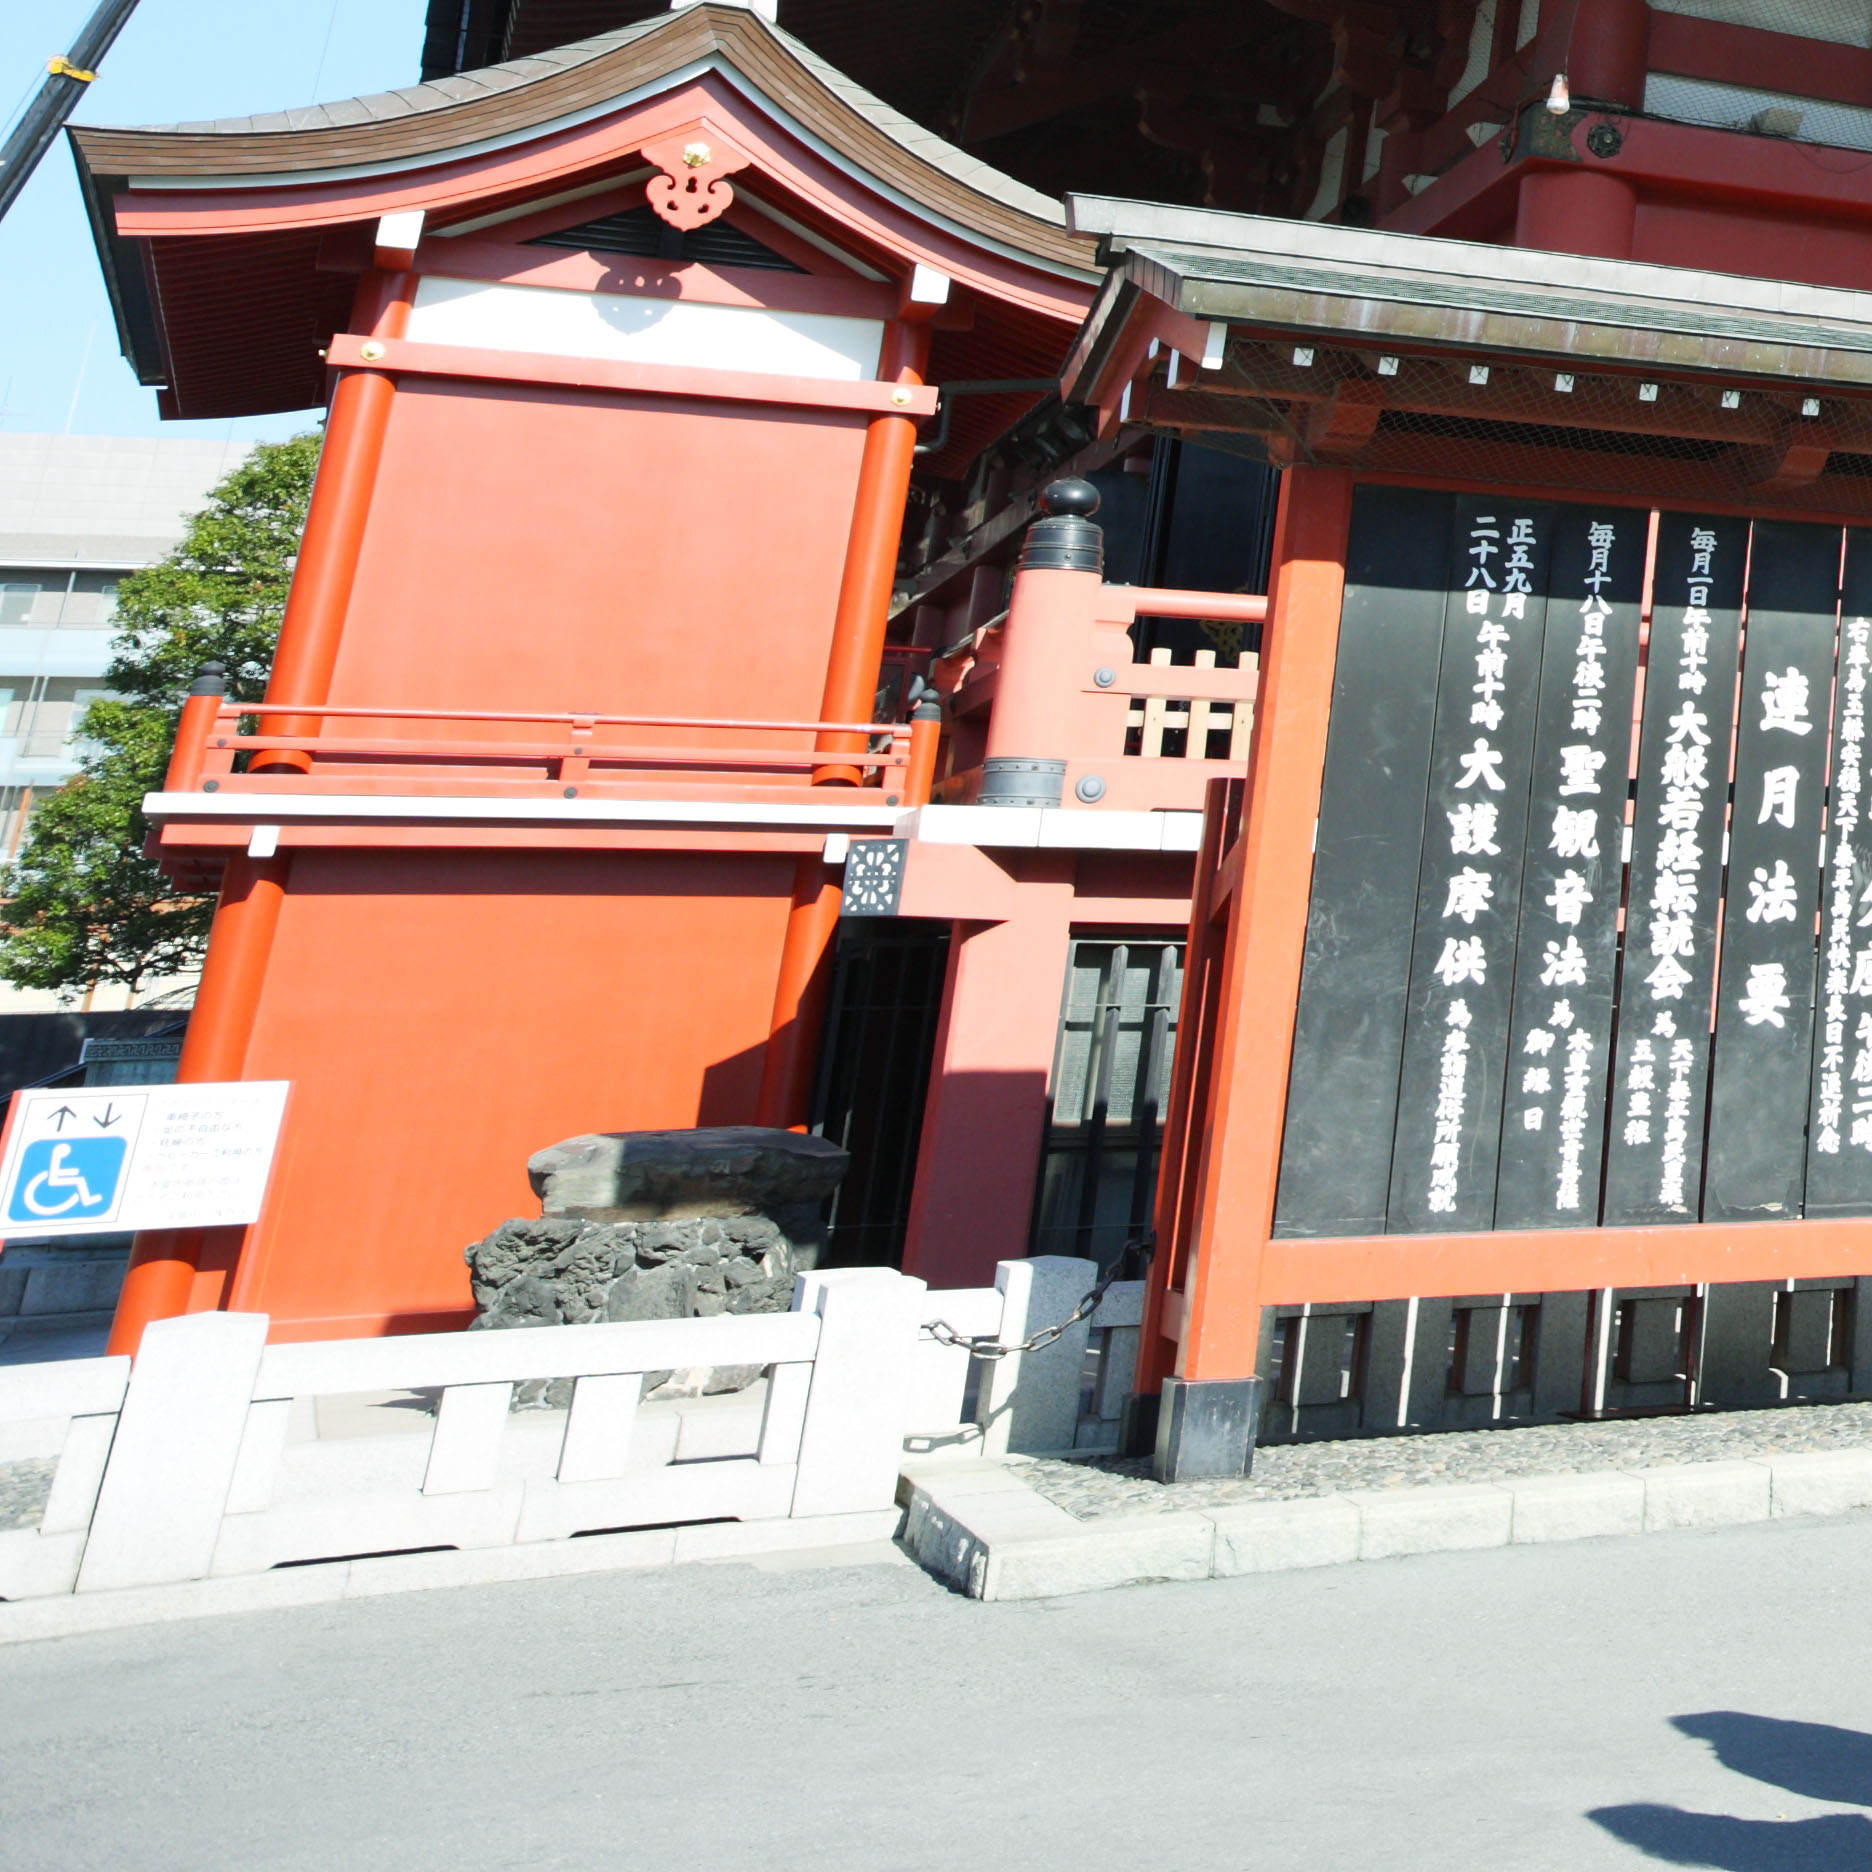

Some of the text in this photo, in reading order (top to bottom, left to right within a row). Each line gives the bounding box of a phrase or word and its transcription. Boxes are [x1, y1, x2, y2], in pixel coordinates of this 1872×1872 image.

[1464, 516, 1500, 615] 二十八日
[1501, 517, 1536, 620] 正五九月
[1571, 521, 1616, 736] 毎月十八日午後二時
[1678, 527, 1718, 696] 毎月一日午前十時
[1469, 620, 1510, 731] 午前十時
[1433, 737, 1506, 986] 大護摩供
[1540, 744, 1607, 987] 聖観音法
[1644, 700, 1712, 1000] 大般若経転読会
[1737, 667, 1812, 1030] 連月法要
